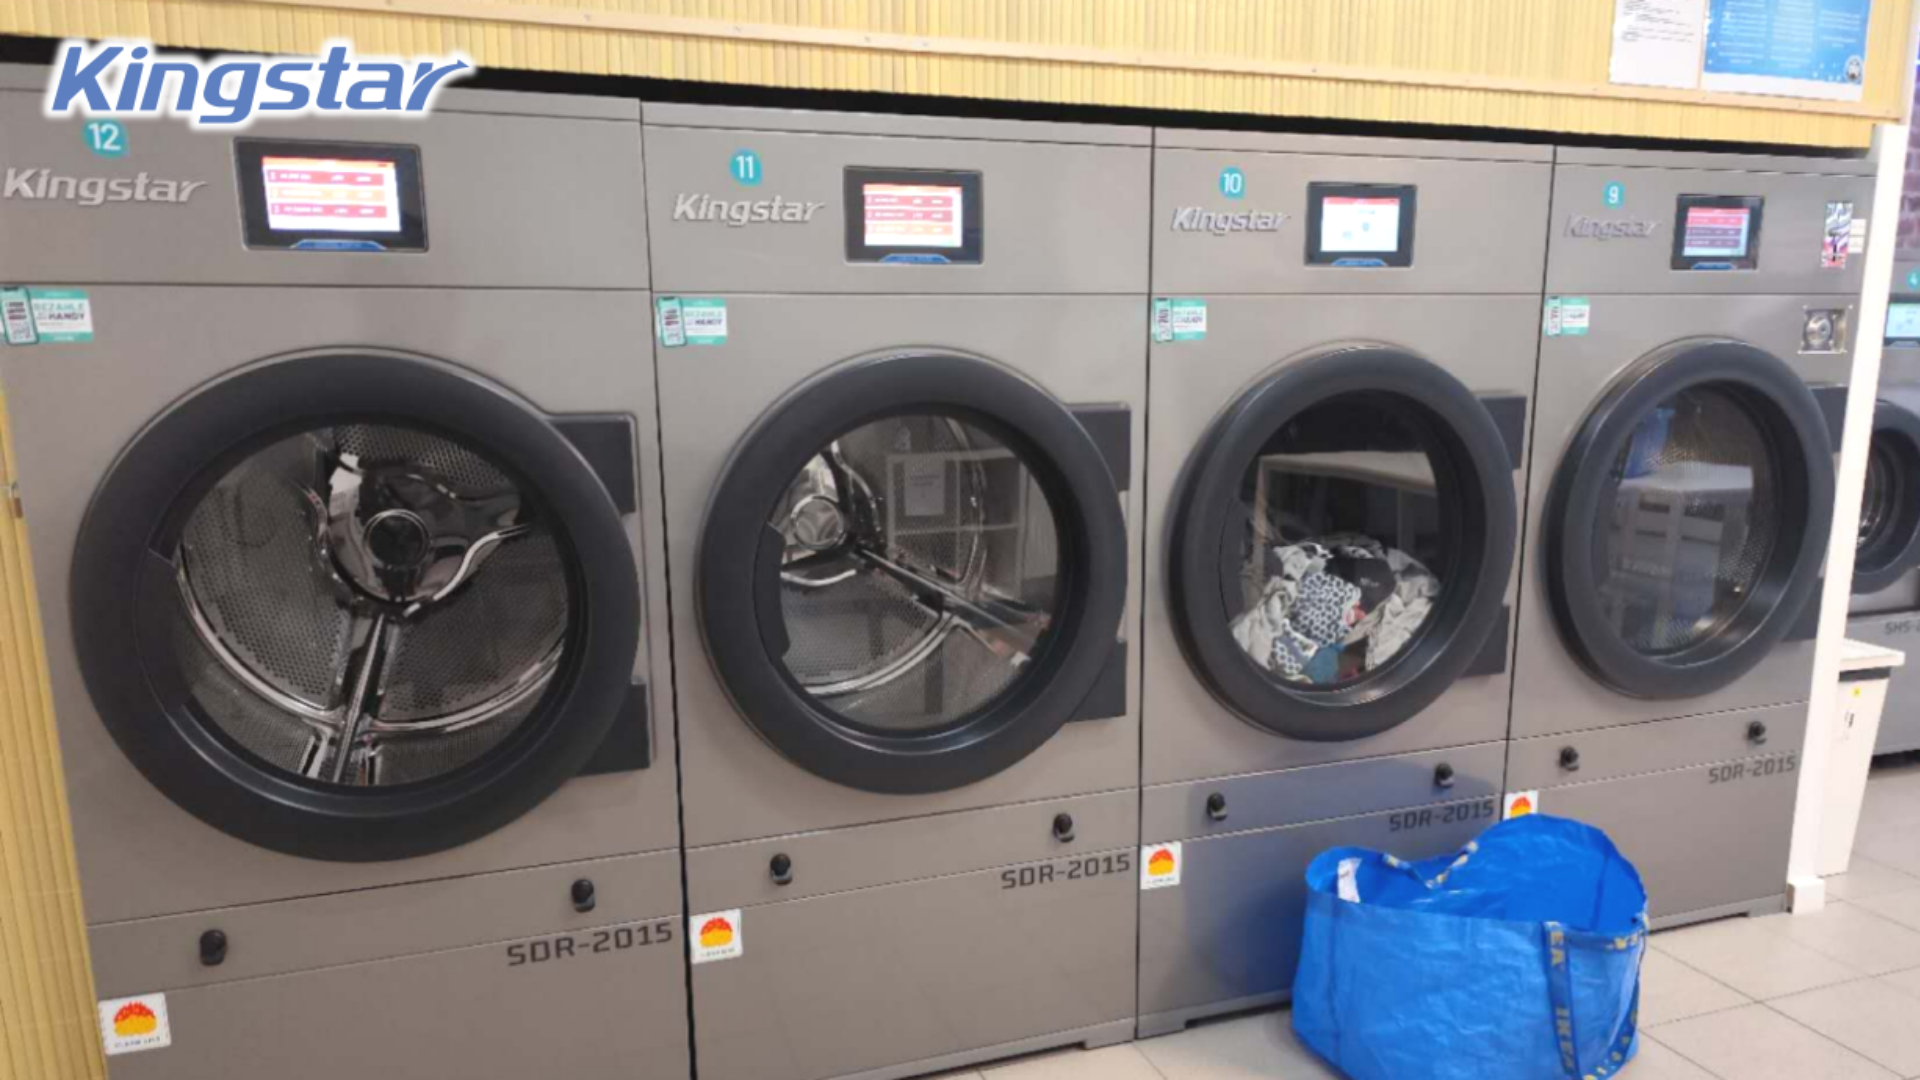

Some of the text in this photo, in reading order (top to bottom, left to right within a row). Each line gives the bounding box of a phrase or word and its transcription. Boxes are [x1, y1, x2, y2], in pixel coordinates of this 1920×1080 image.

[88, 122, 121, 151] 12
[735, 155, 754, 179] 11
[3, 167, 206, 206] Kingstar
[1223, 172, 1242, 194] 10
[1608, 185, 1620, 205] 9
[673, 193, 825, 227] Kingstar
[1171, 206, 1290, 236] Kingstar
[1708, 755, 1796, 784] SDR-2015
[1389, 798, 1495, 833] SDR-2015
[1001, 853, 1131, 890] SDR-2015
[506, 921, 673, 966] SDR-2015
